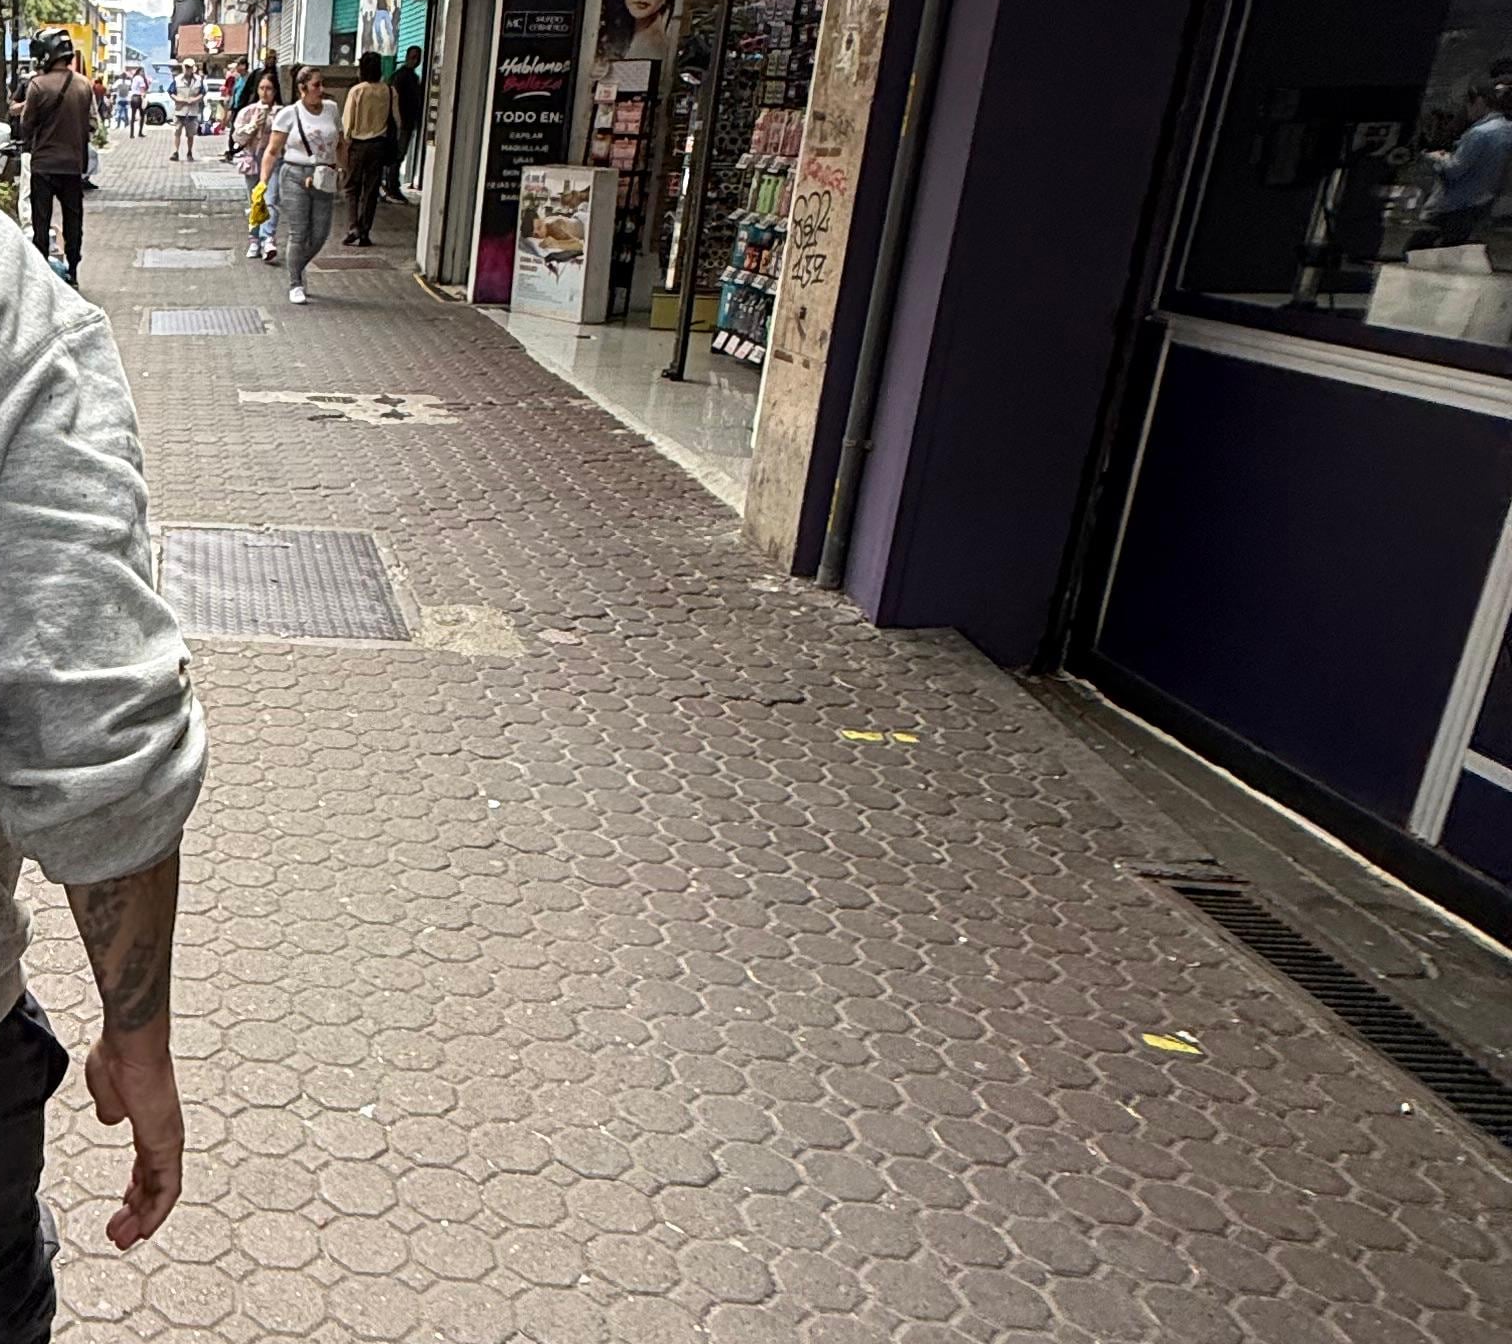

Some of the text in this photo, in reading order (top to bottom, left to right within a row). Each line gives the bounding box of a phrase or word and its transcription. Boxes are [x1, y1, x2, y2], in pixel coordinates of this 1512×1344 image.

[498, 55, 571, 77] Hablamos
[495, 111, 564, 124] TODO EN:
